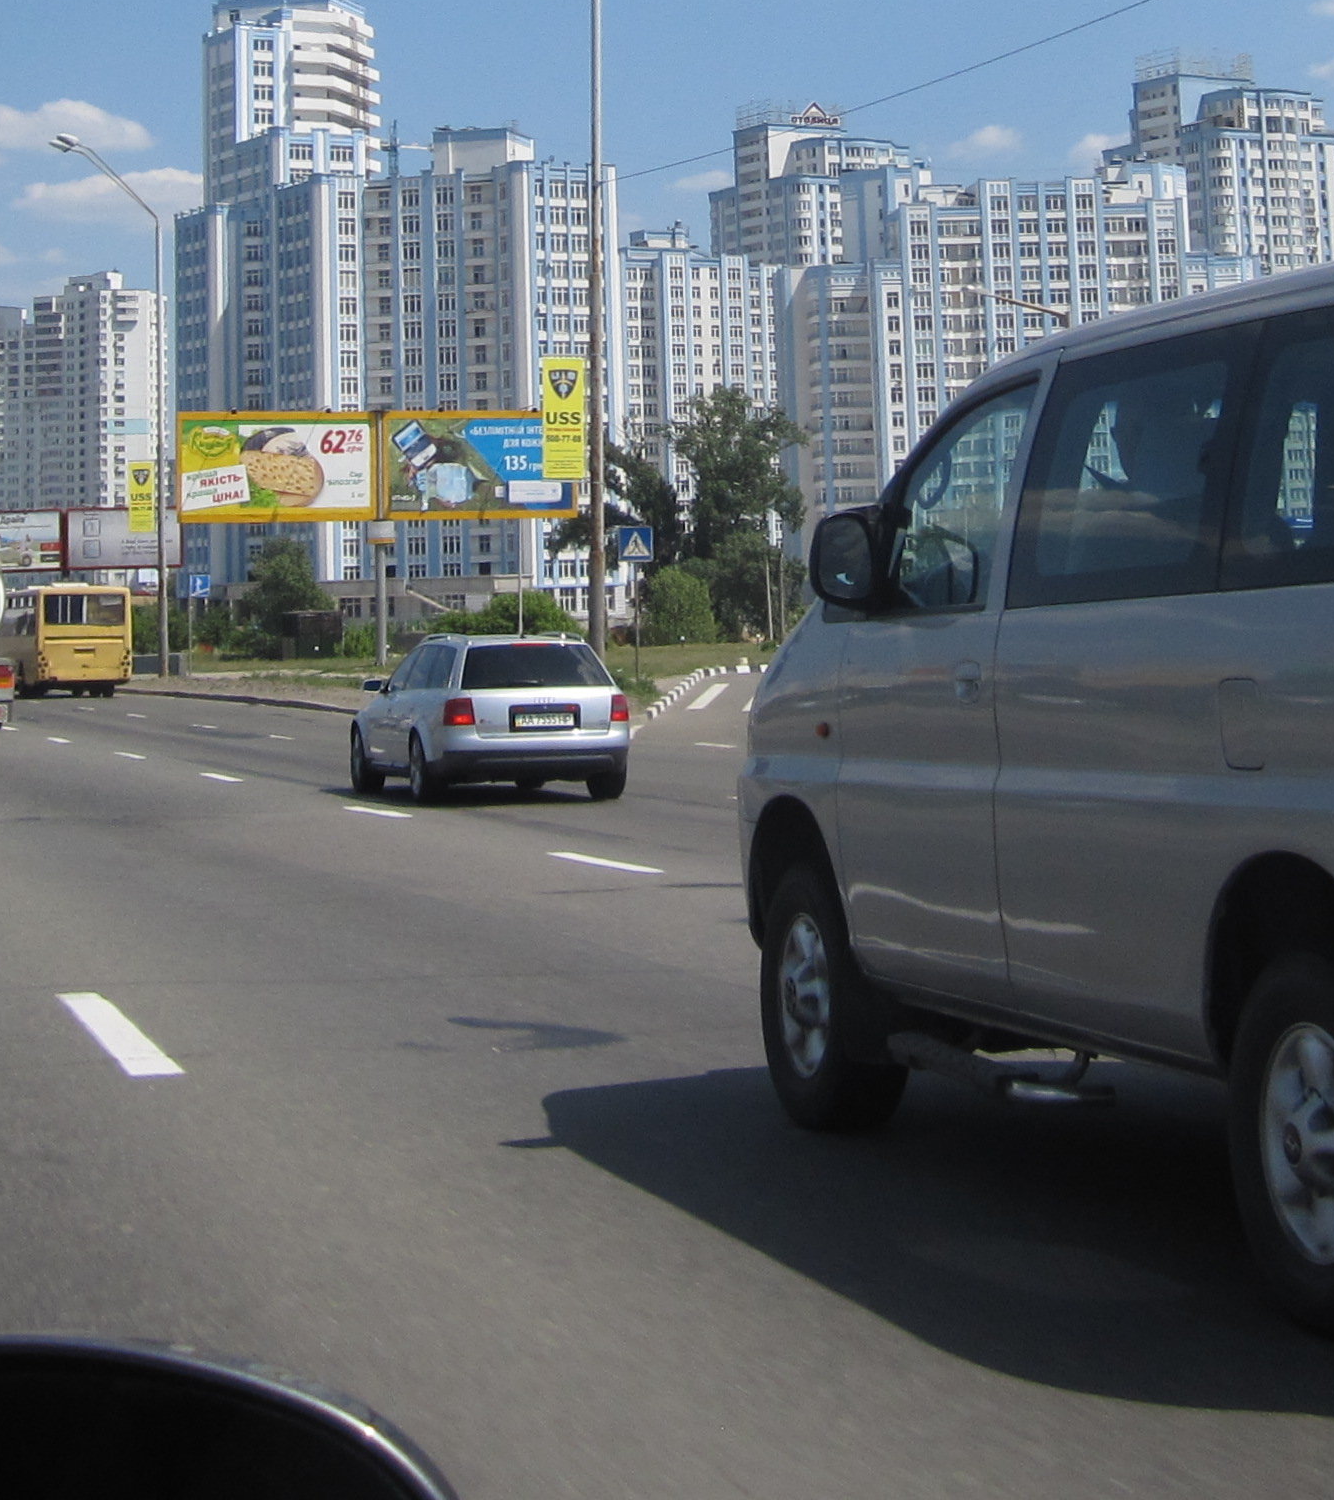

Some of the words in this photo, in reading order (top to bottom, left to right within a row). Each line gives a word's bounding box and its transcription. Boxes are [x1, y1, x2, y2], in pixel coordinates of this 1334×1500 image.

[545, 411, 581, 425] USS
[320, 429, 347, 455] 62
[347, 429, 363, 442] 76
[504, 455, 527, 471] 135
[130, 493, 152, 502] USS
